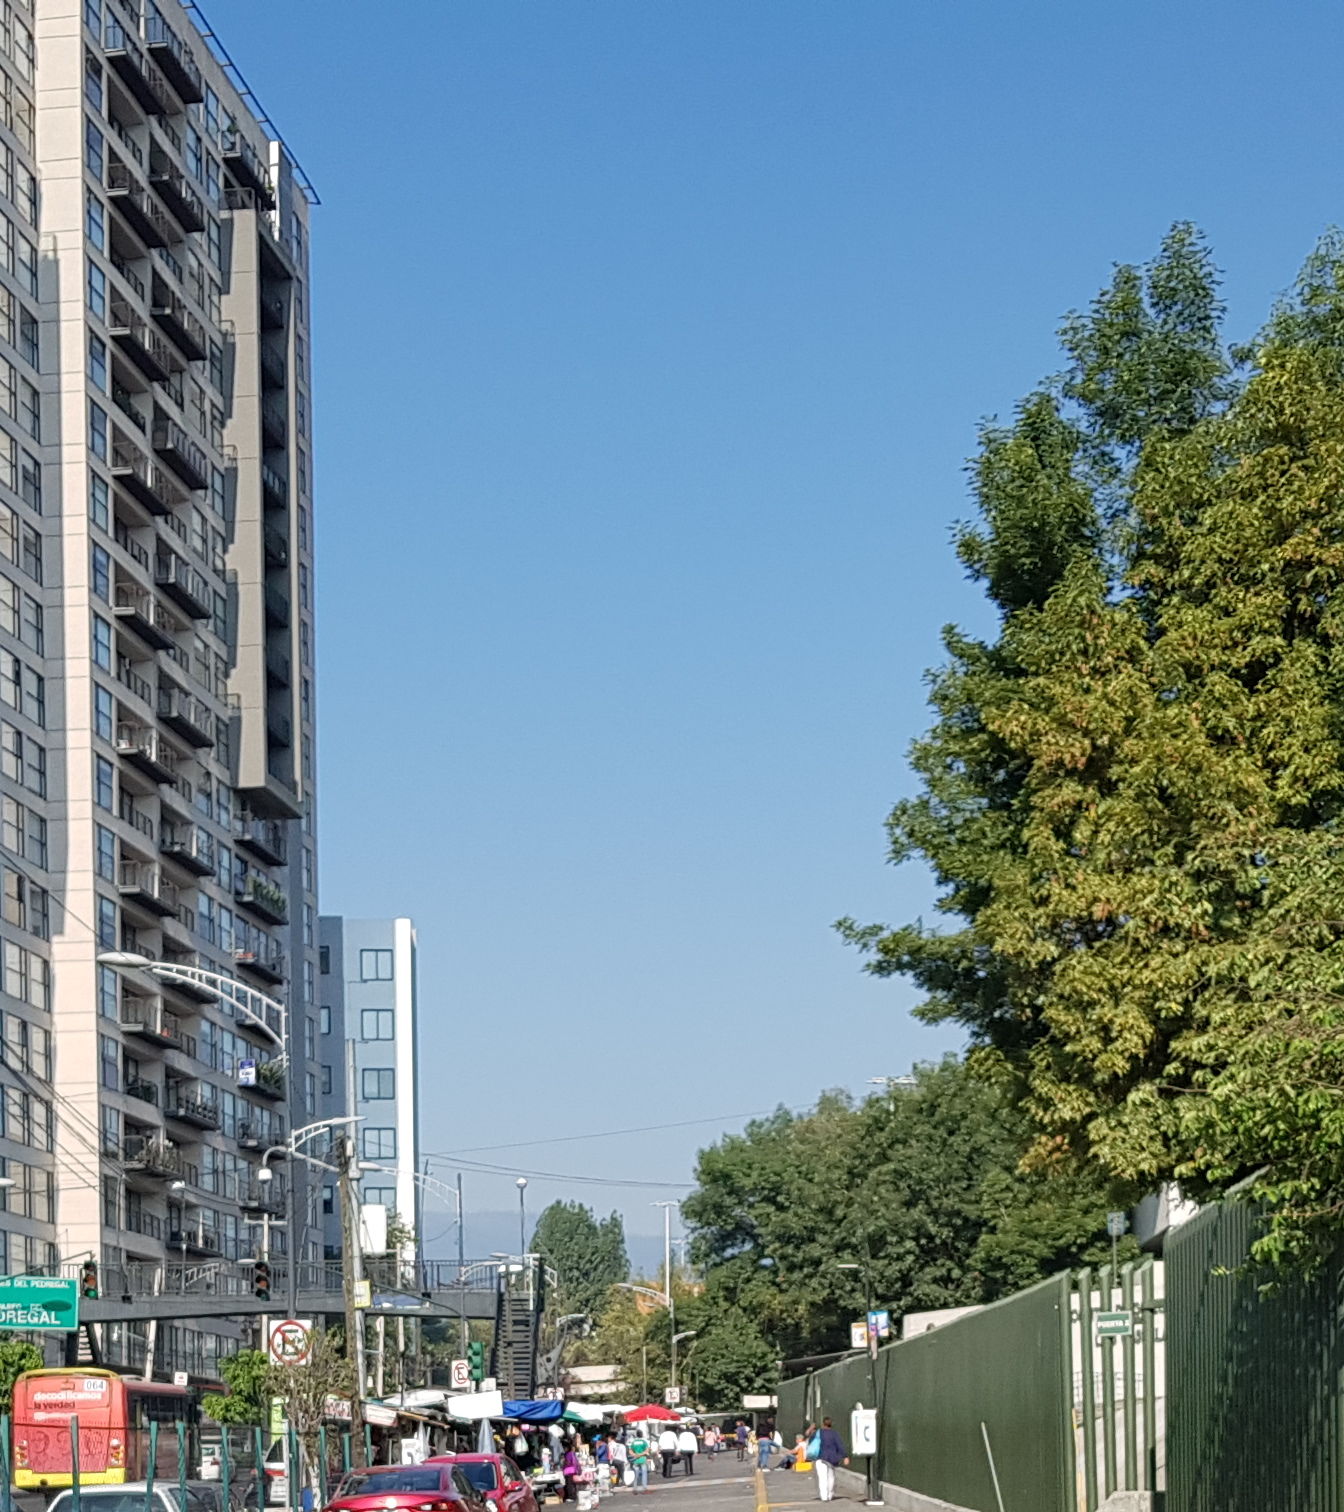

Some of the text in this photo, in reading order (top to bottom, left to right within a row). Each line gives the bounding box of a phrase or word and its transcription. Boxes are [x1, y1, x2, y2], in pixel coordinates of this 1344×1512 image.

[14, 1279, 29, 1288] DEL
[30, 1280, 70, 1289] PEDREGAL
[86, 1380, 104, 1390] 064
[43, 1401, 75, 1409] verdad
